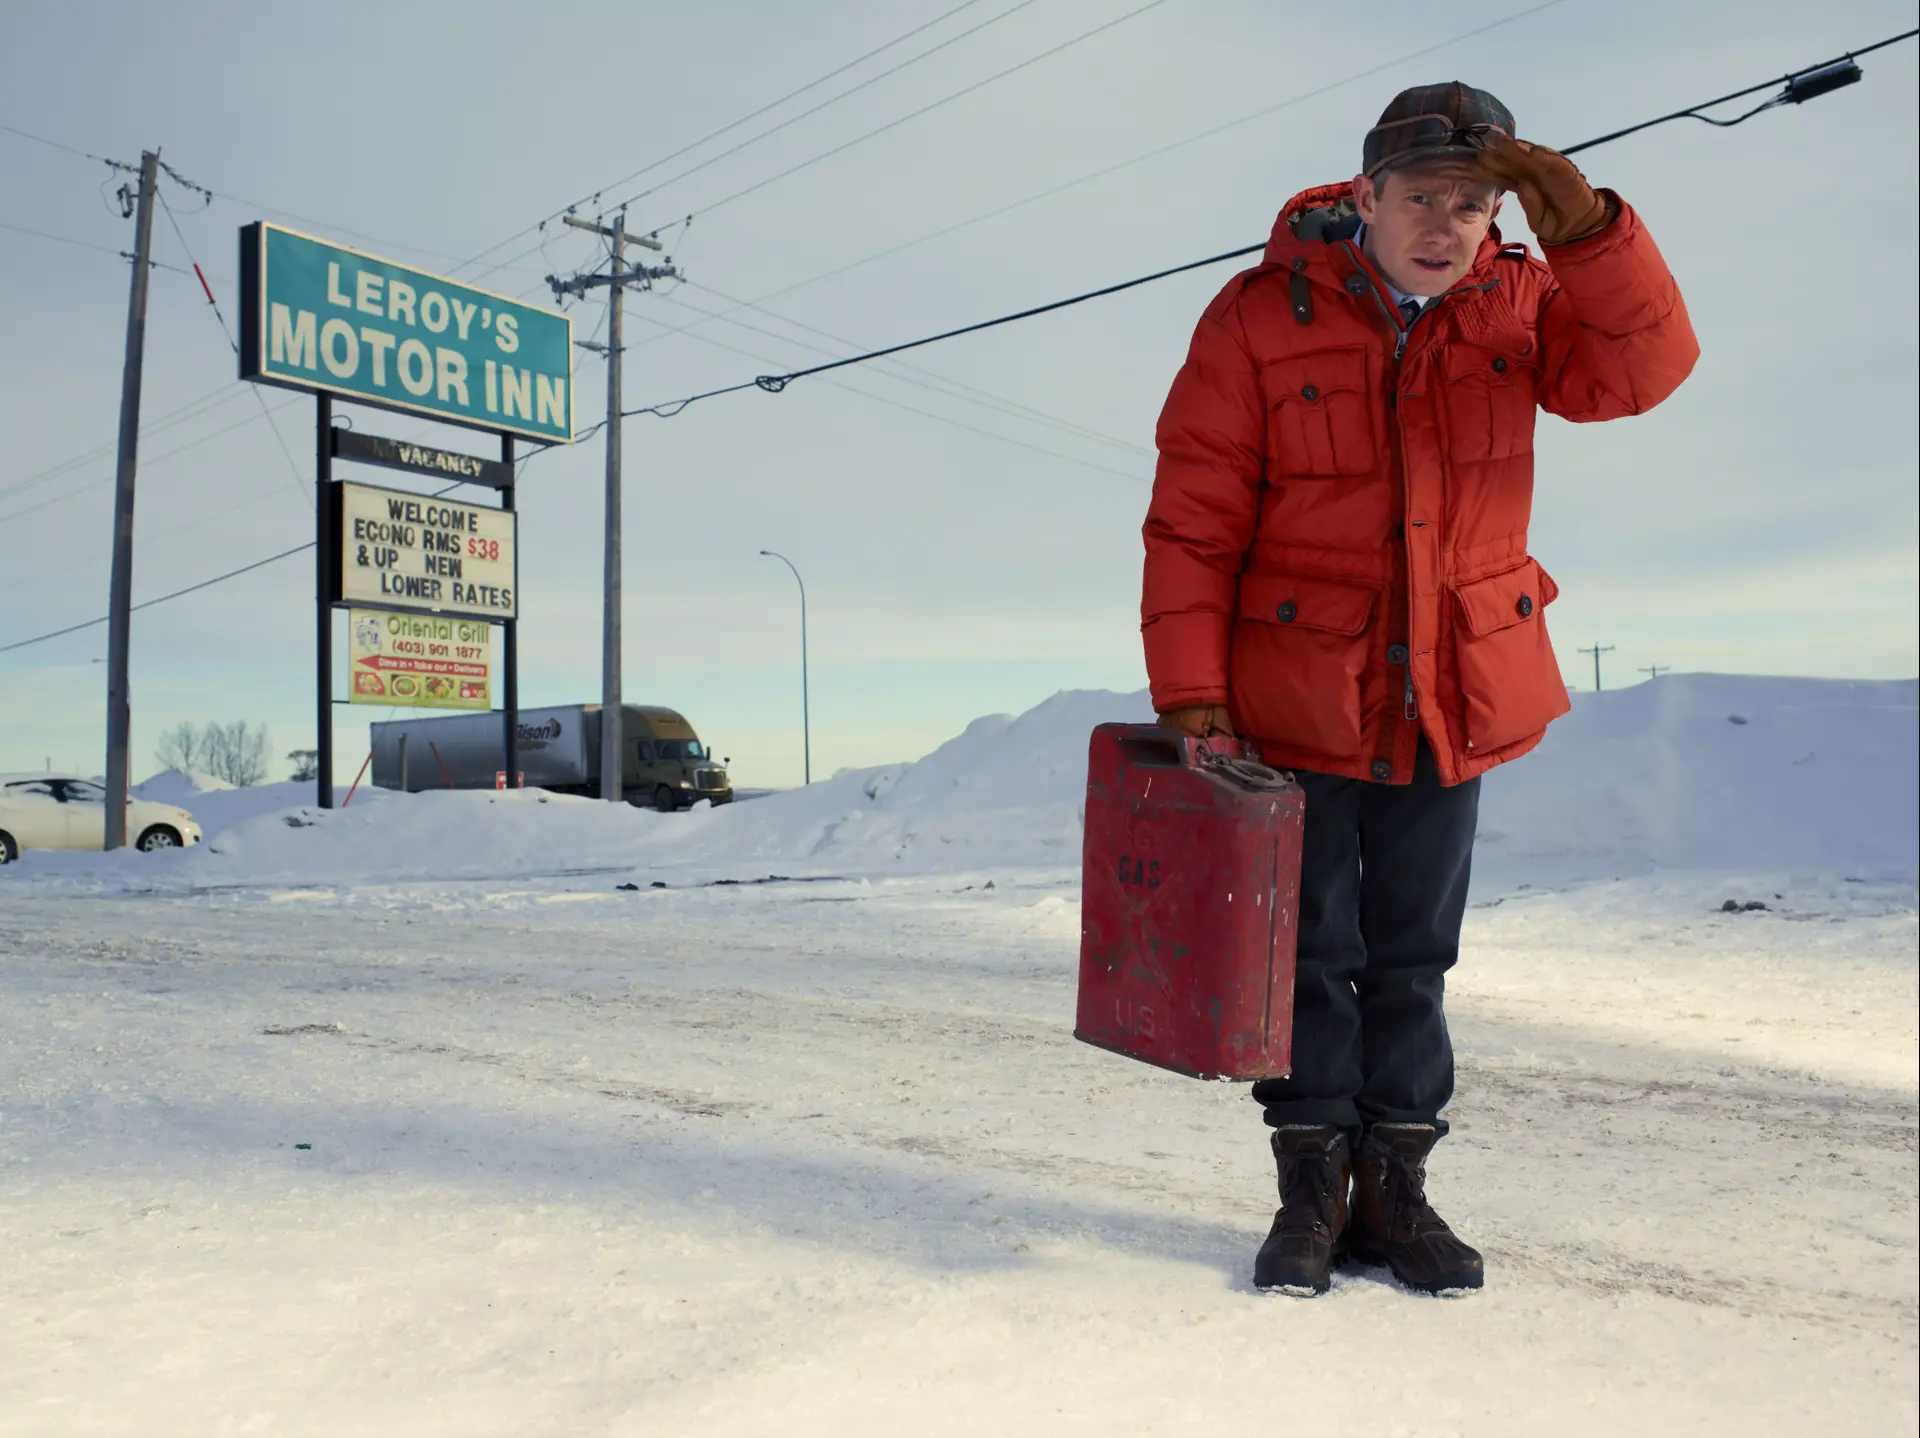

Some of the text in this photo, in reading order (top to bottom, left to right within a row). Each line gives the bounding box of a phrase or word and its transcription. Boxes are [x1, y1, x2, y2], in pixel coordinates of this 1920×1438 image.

[327, 261, 520, 353] LEROY'S
[270, 302, 566, 429] MOTOR INN
[399, 446, 483, 477] VACANCY
[387, 498, 478, 533] WELCOME
[354, 518, 499, 561] ECONO RMS $38
[424, 554, 462, 578] NEW
[381, 572, 512, 609] LOWER RATES
[387, 614, 490, 644] Oriental Grill
[392, 639, 483, 659] (403) 901 1877
[378, 658, 486, 676] Dine in Take out Delivery
[1117, 854, 1161, 890] GAS
